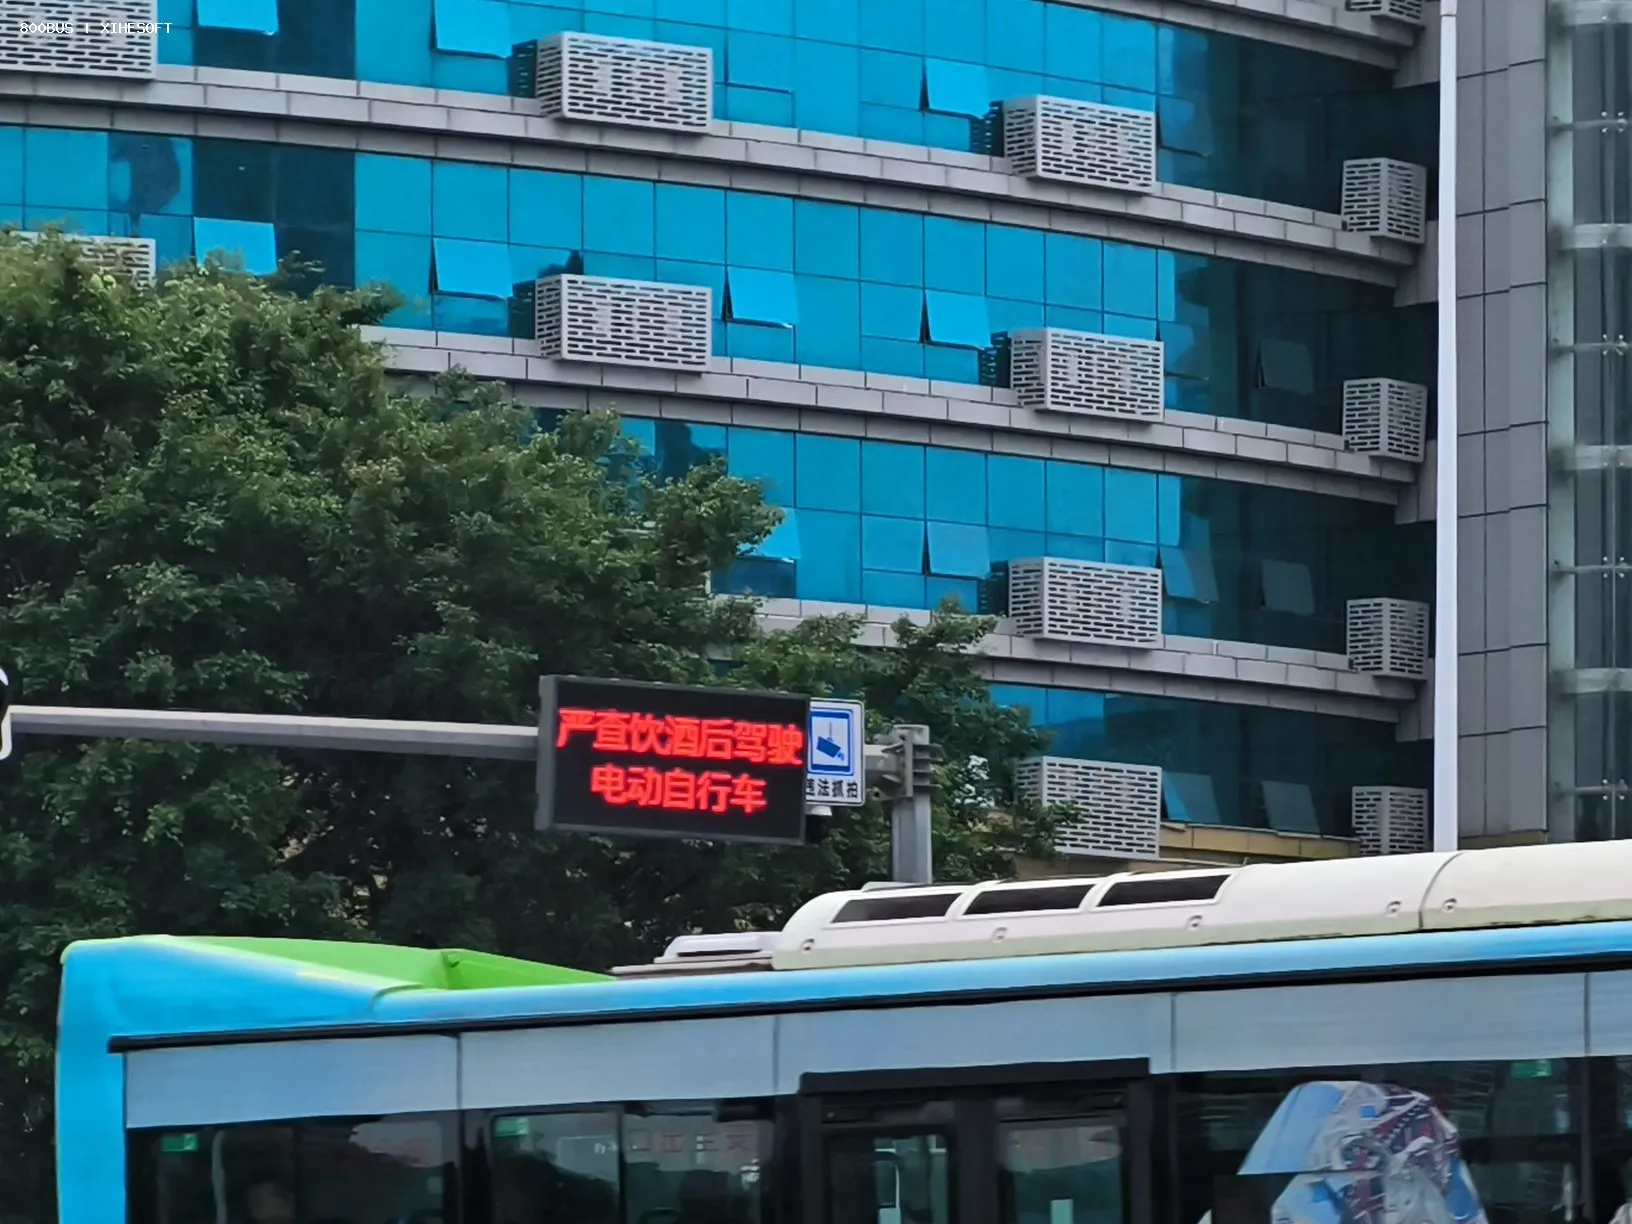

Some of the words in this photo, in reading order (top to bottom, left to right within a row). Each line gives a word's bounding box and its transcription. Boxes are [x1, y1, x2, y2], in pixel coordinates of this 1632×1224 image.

[556, 707, 804, 767] 严查饮酒后驾驶
[590, 763, 768, 814] 电动自行车
